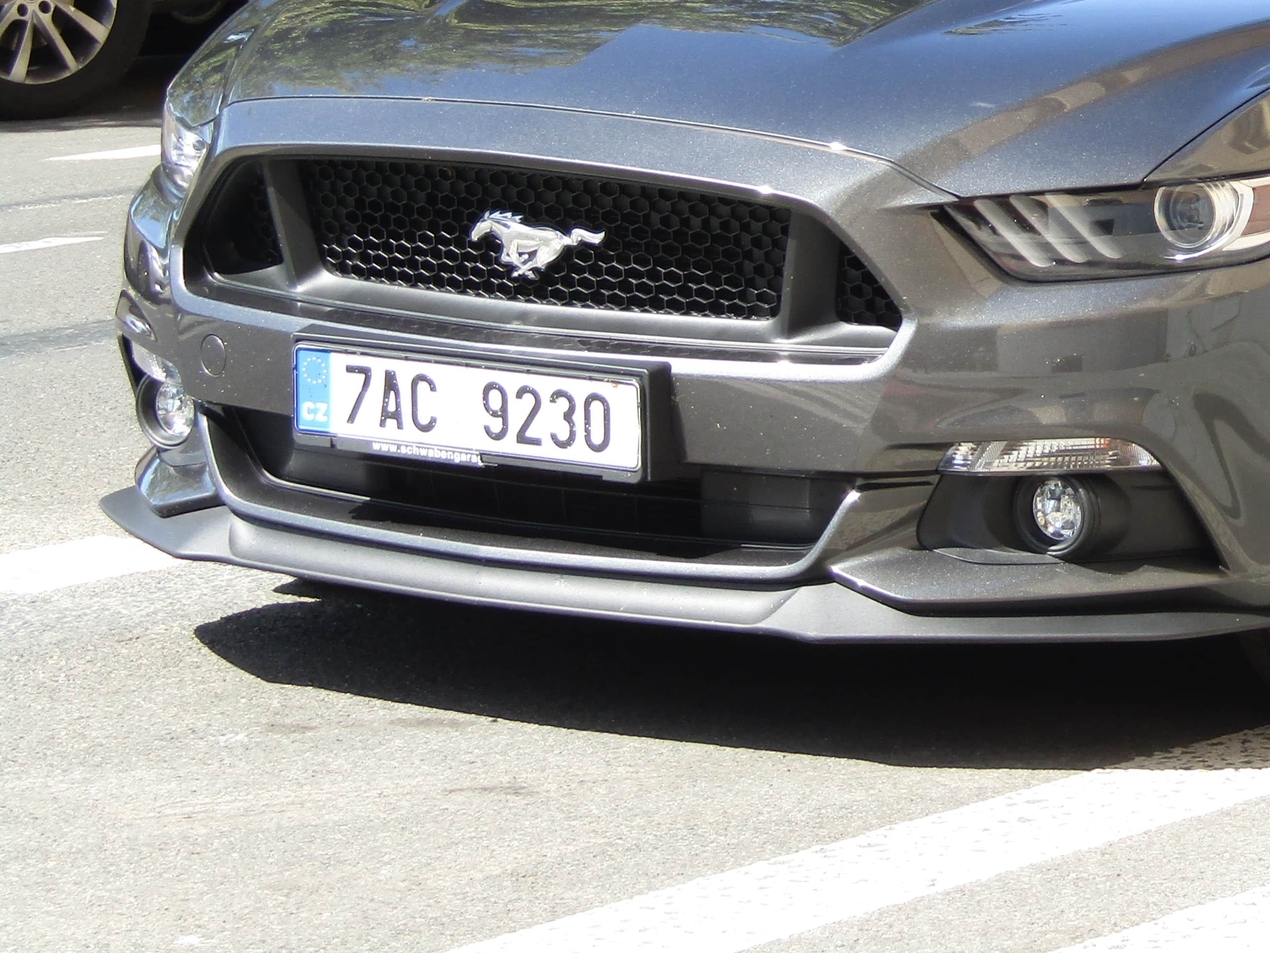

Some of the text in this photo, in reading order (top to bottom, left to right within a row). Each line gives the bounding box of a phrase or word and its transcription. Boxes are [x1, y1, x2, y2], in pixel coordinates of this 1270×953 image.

[301, 401, 329, 422] CZ
[345, 364, 611, 453] 7AC 9230
